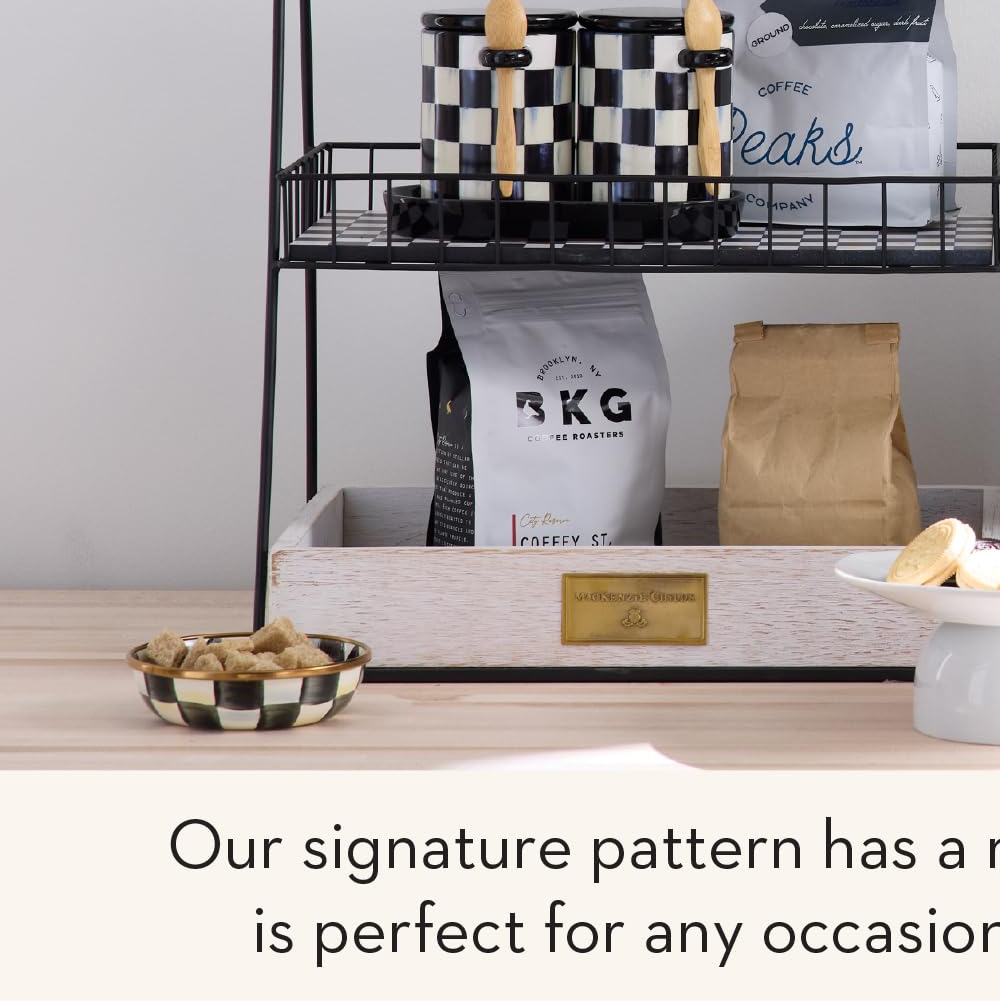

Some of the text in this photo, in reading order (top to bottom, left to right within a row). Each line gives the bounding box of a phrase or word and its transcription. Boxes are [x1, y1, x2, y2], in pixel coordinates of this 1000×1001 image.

[751, 23, 790, 48] GROUND
[758, 81, 813, 98] COFFEE
[746, 193, 815, 211] COMPANY
[589, 364, 603, 378] NY
[516, 387, 632, 428] BKG
[572, 431, 625, 441] ROASTERS
